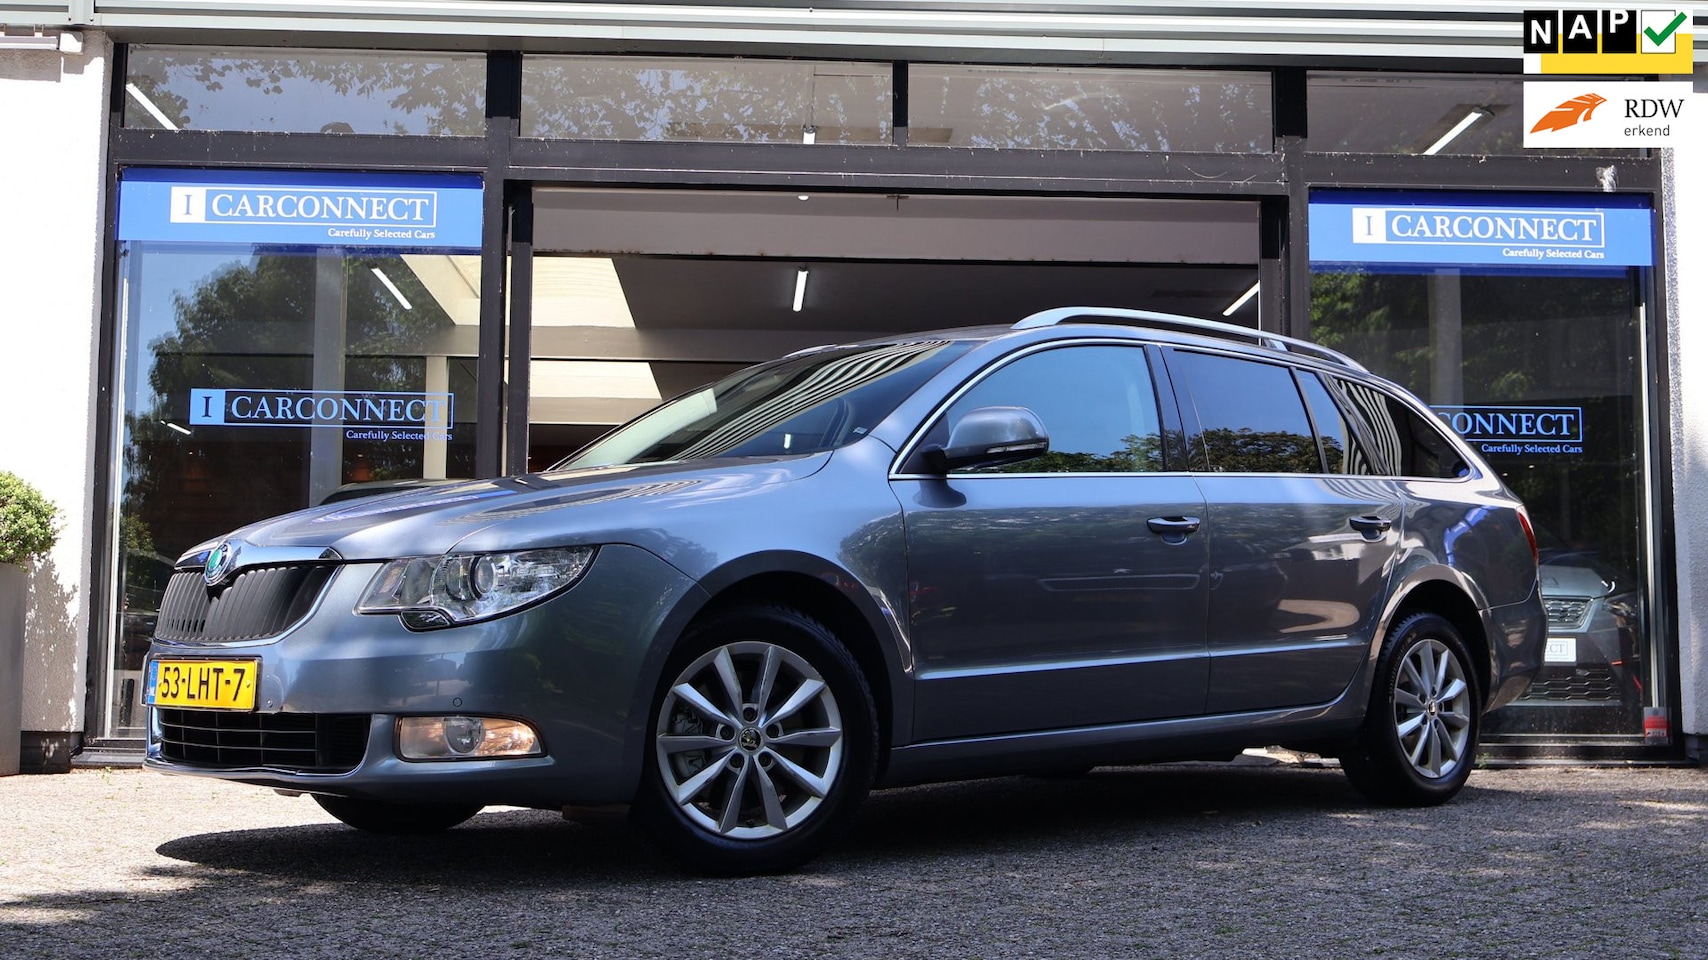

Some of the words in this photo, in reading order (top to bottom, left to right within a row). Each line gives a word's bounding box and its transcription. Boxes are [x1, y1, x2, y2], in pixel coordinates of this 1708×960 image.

[211, 193, 429, 221] CARCONNECT
[327, 228, 372, 240] Carefully
[373, 229, 412, 239] Selected
[414, 230, 436, 239] Cars
[1391, 214, 1597, 241] CARCONNECT
[1502, 248, 1544, 260] Carefully
[1546, 249, 1582, 258] Selected
[1584, 250, 1605, 259] Cars
[231, 396, 446, 423] CARCONNECT
[346, 430, 390, 442] Carefully
[391, 431, 430, 440] Selected
[431, 432, 453, 441] Cars
[1481, 443, 1522, 455] Carefully
[1524, 444, 1561, 453] Selected
[1562, 444, 1583, 454] Cars
[161, 666, 246, 702] 53-LHT-7
